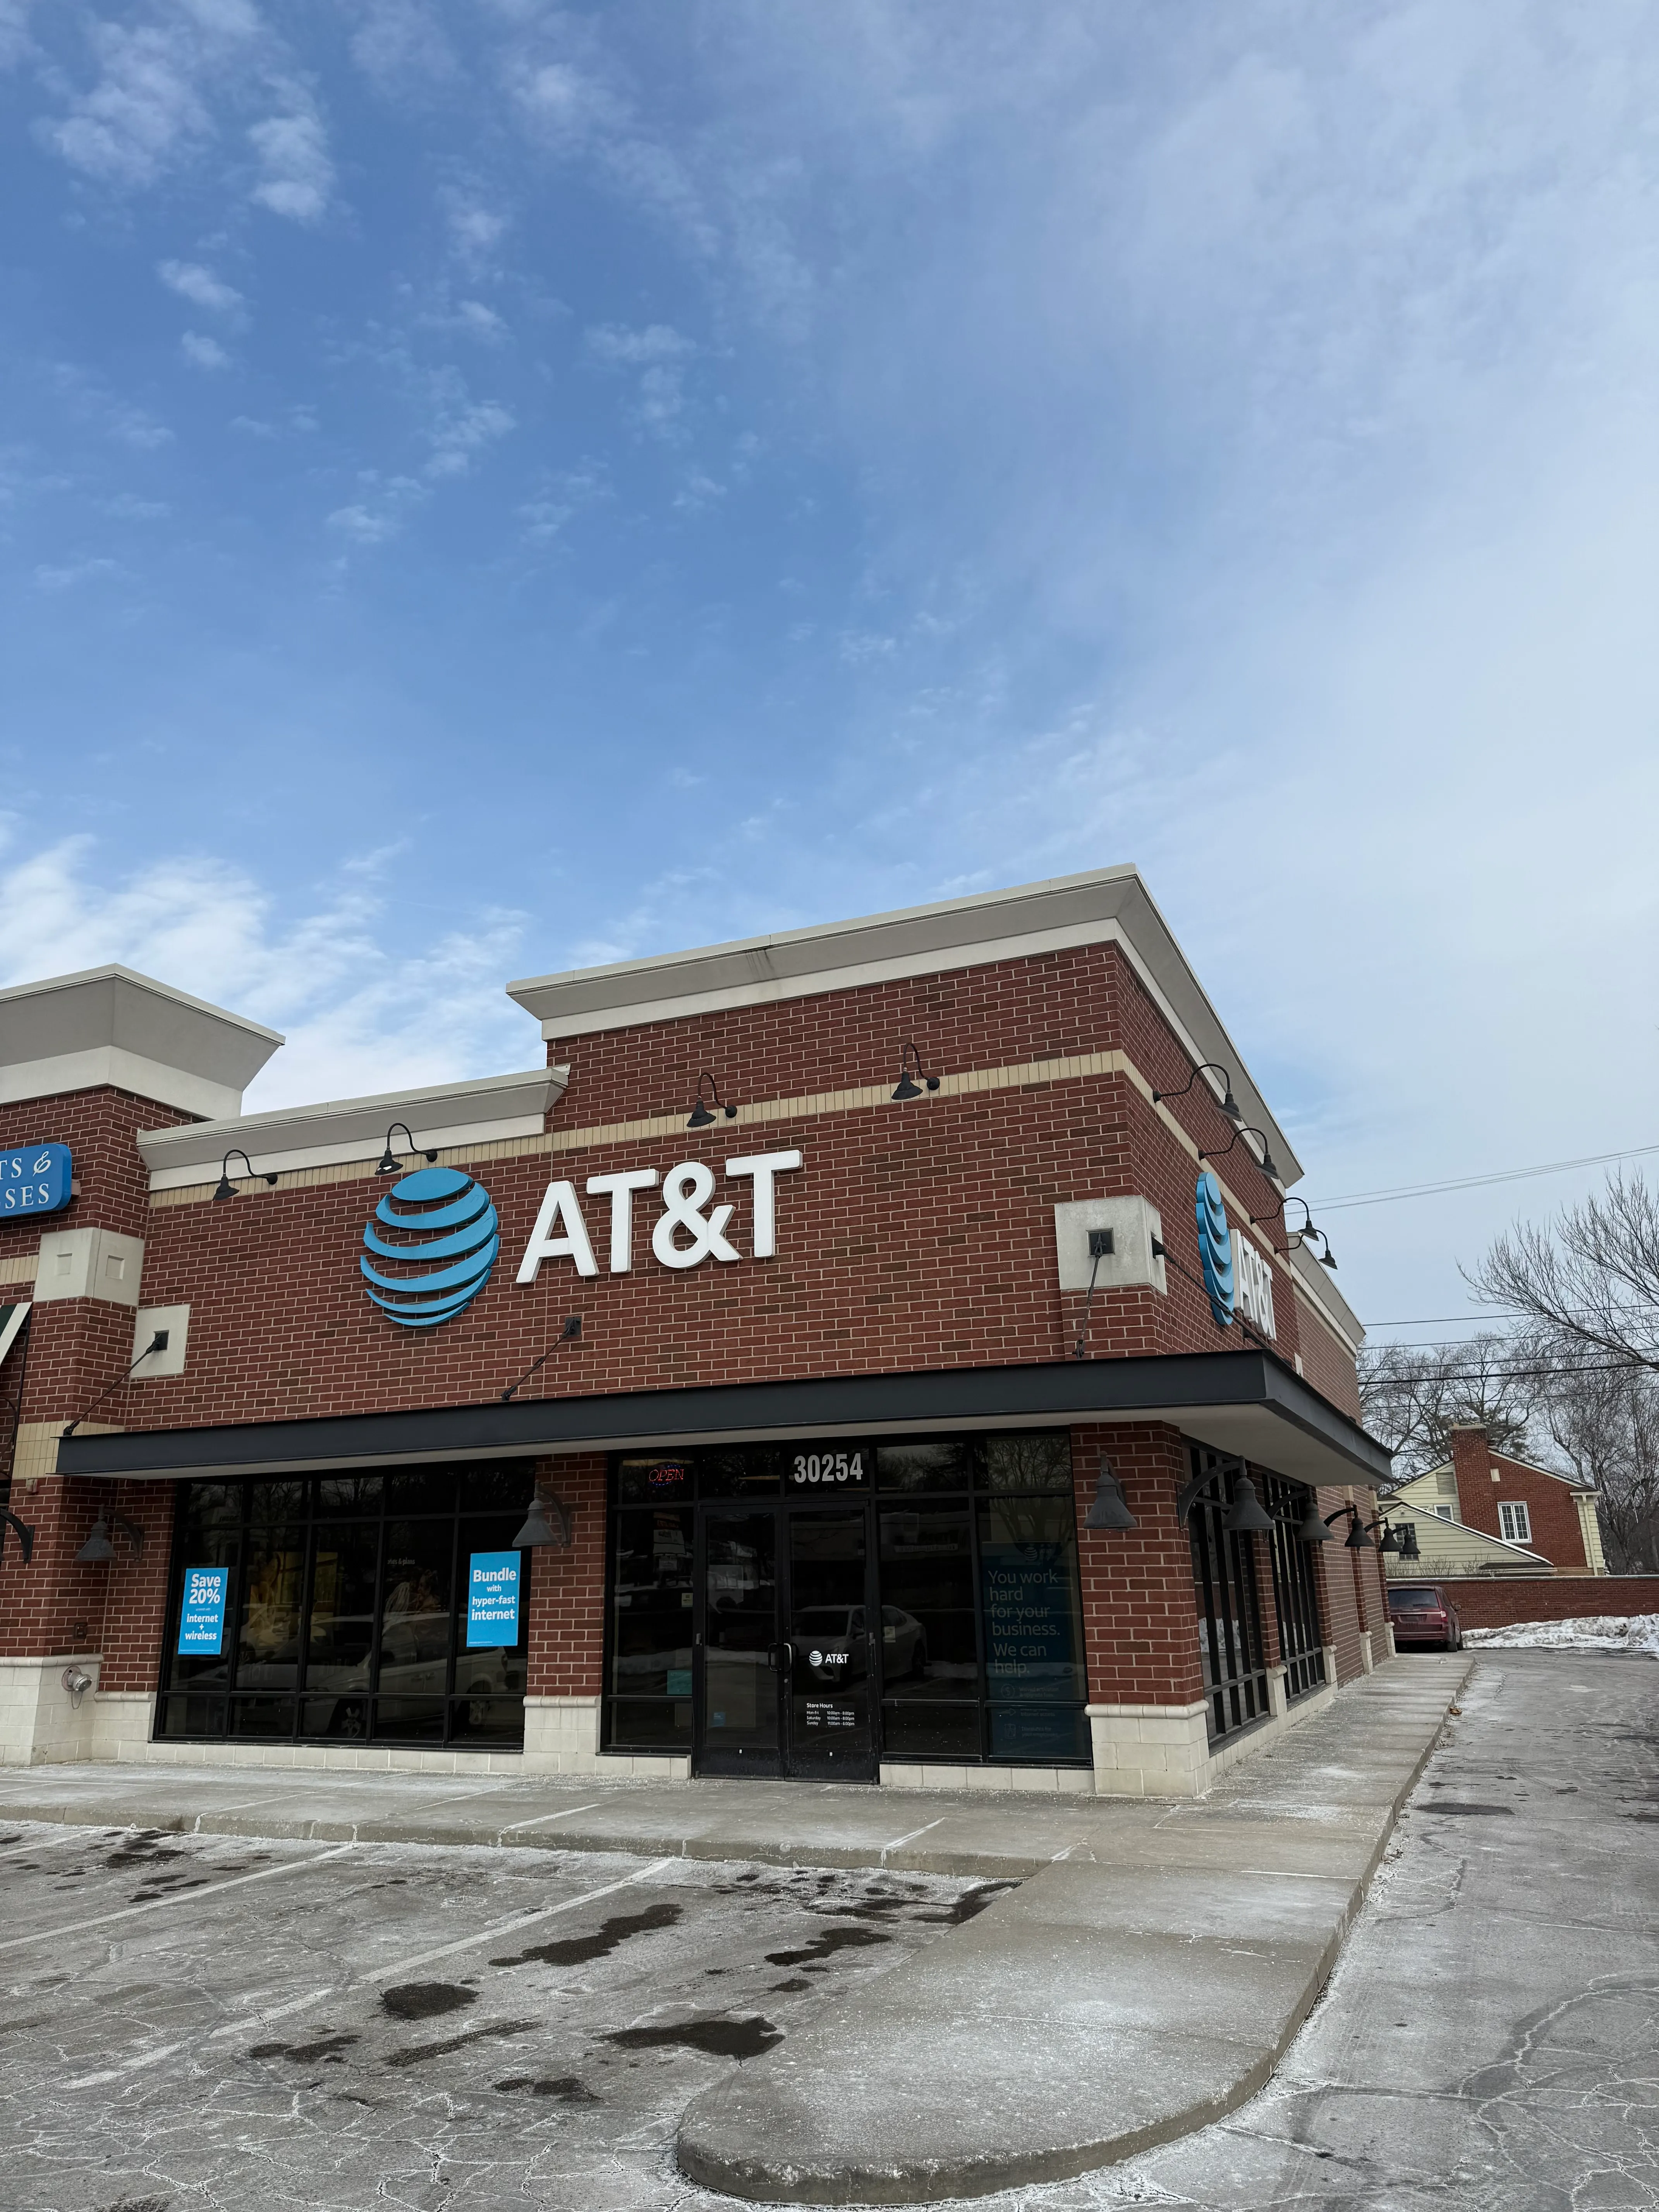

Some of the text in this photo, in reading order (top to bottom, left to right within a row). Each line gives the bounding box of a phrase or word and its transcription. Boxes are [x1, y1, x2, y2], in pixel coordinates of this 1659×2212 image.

[33, 1151, 51, 1177] &
[0, 1183, 49, 1209] SES
[516, 1149, 803, 1283] AT&T
[649, 1469, 684, 1482] OPEN
[794, 1453, 863, 1483] 30254
[191, 1573, 221, 1587] Save
[473, 1567, 517, 1582] Bundle
[988, 1568, 1058, 1584] You work
[189, 1588, 220, 1604] 20%
[472, 1595, 515, 1607] hyper-fast
[990, 1586, 1023, 1601] hard
[187, 1614, 218, 1623] internet
[472, 1608, 515, 1620] internet
[990, 1603, 1050, 1621] for your
[185, 1631, 217, 1640] wireless
[992, 1621, 1060, 1636] business.
[993, 1643, 1047, 1657] We can
[825, 1654, 849, 1664] AT&T
[994, 1659, 1030, 1677] help.
